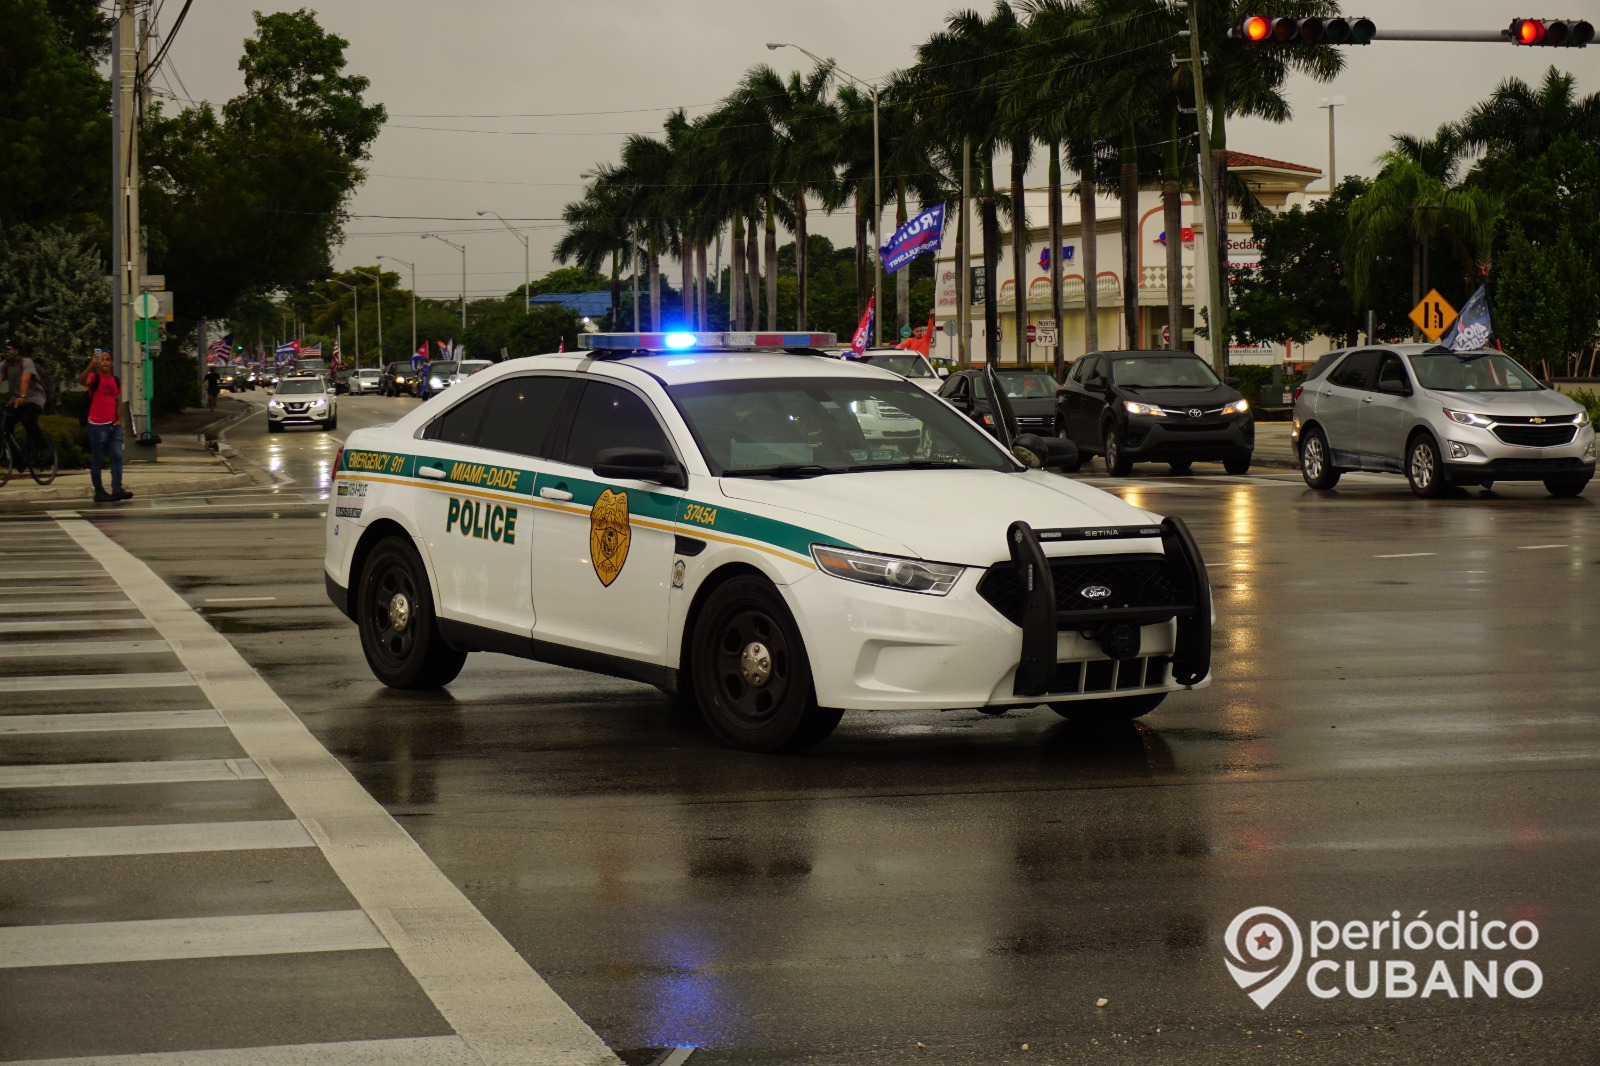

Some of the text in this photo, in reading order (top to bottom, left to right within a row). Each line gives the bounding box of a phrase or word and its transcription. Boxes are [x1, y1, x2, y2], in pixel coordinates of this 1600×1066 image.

[1037, 335, 1053, 343] 973
[348, 452, 405, 472] EMERGENCY 911
[450, 462, 521, 490] MIAMI-DADE
[446, 496, 518, 545] POLICE
[683, 503, 718, 526] 3745A
[1084, 529, 1119, 537] SETINA
[1089, 588, 1106, 598] Ford
